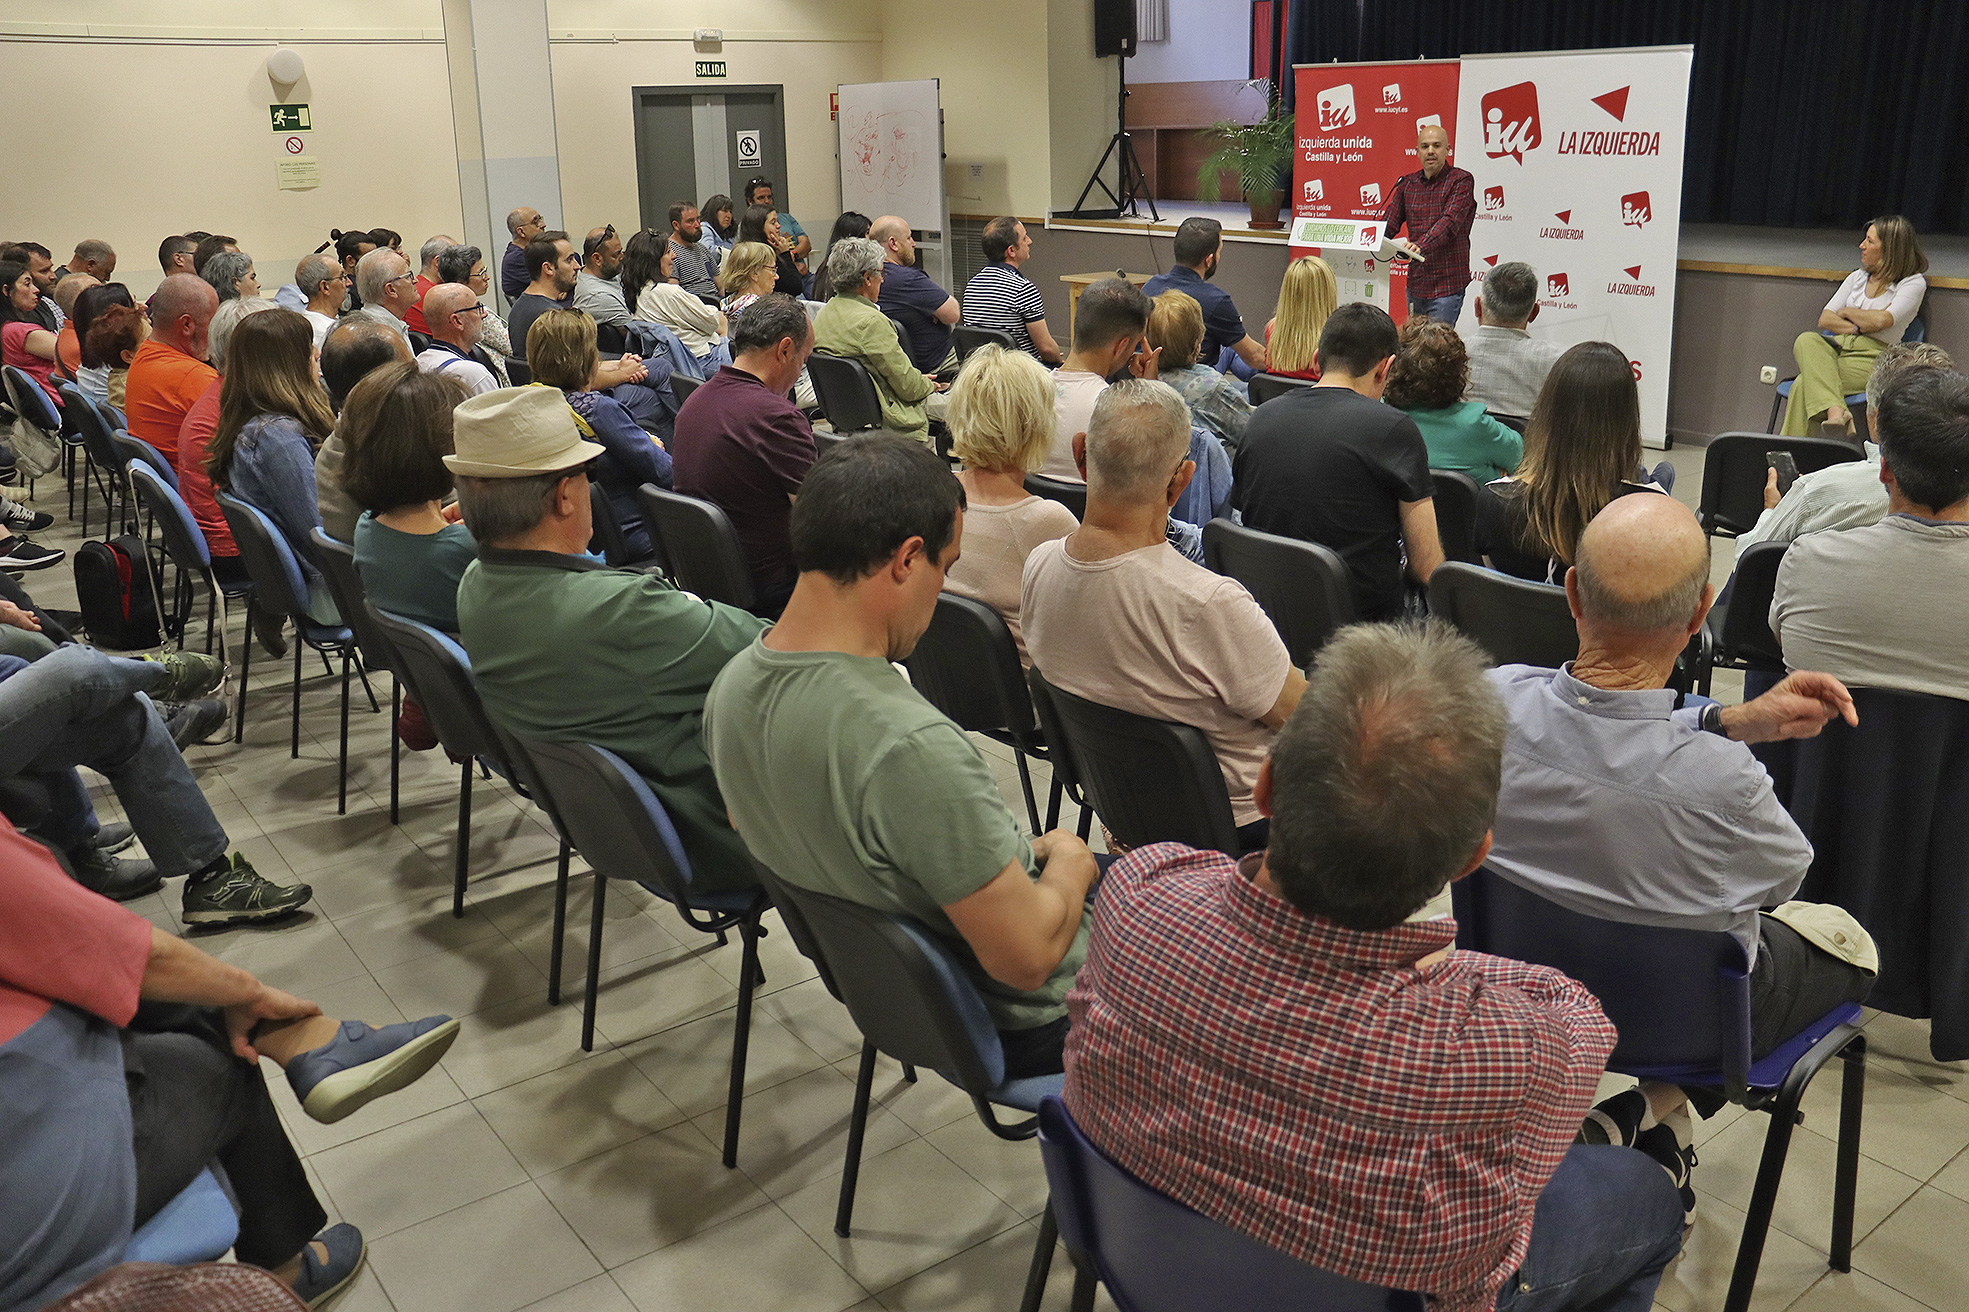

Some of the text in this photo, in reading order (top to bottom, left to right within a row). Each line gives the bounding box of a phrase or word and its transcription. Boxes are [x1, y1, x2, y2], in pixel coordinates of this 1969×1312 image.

[696, 63, 726, 76] SALIDA
[1485, 107, 1535, 154] iu
[1298, 136, 1373, 151] izquierda unida
[1557, 131, 1661, 157] LA IZQUIERDA
[1305, 151, 1363, 164] Castilla y León
[1473, 212, 1494, 221] Castilla
[1499, 213, 1513, 221] León
[1540, 227, 1584, 241] LA IZQUIERDA
[1606, 282, 1656, 297] LA IZQUIERDA
[1563, 301, 1578, 310] León
